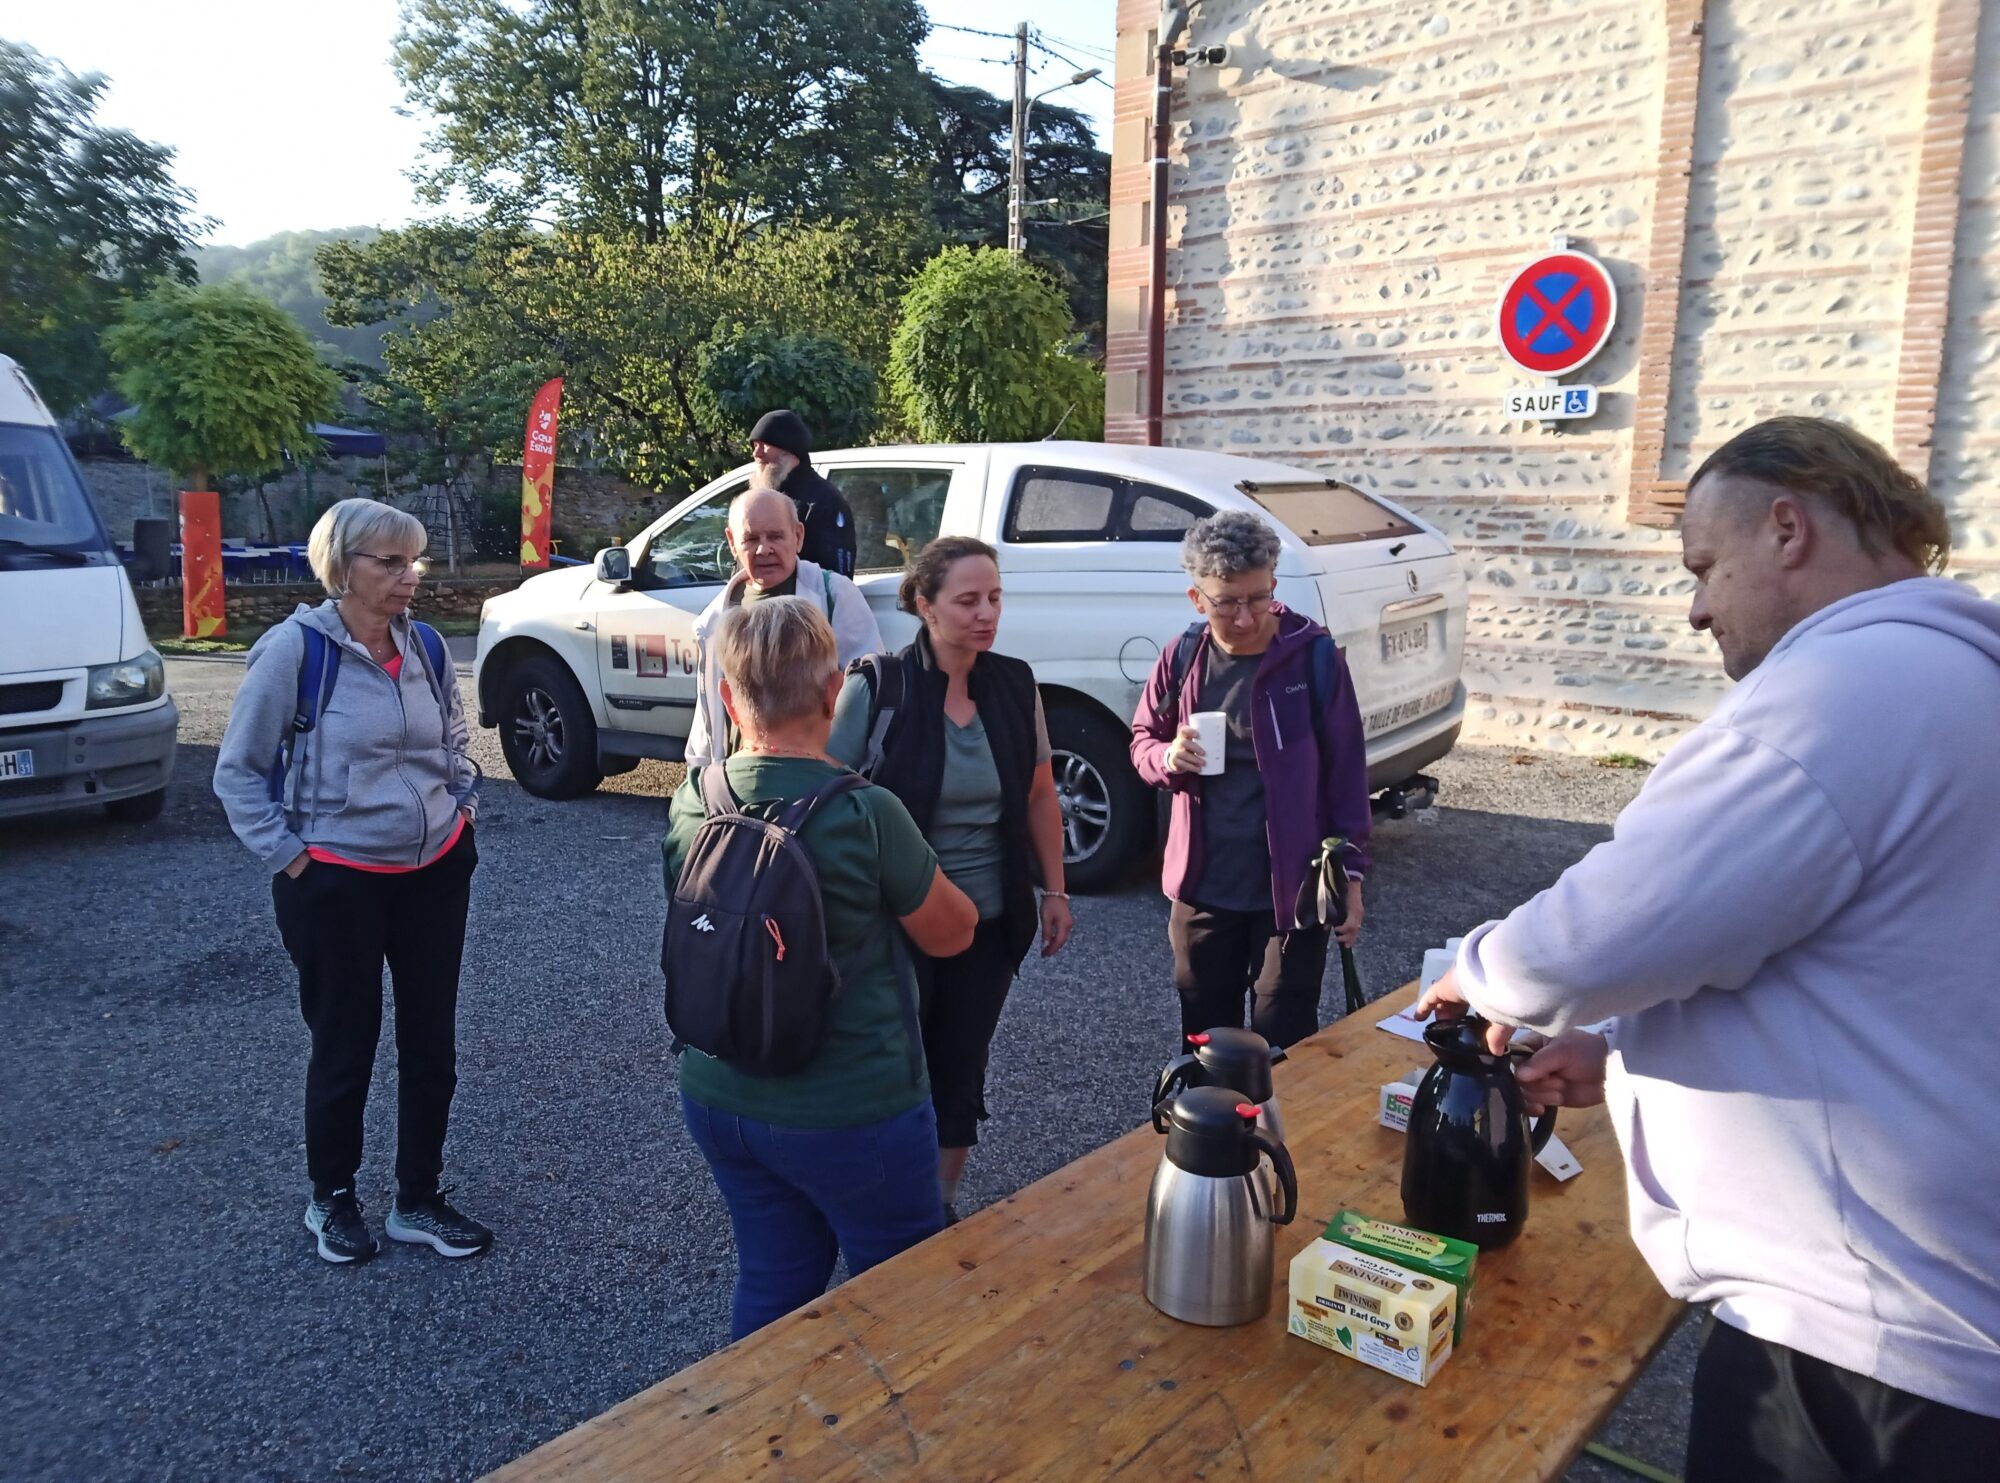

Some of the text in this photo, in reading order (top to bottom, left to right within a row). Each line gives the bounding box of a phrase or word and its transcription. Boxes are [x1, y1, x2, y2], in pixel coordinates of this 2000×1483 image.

[1512, 395, 1561, 412] SAUF
[1477, 1213, 1507, 1223] THERMOS
[1375, 1223, 1433, 1243] TWININGS
[1338, 1264, 1397, 1289] TWININGS
[1317, 1298, 1345, 1311] ORIGINAL
[1338, 1289, 1378, 1310] TWININGS
[1350, 1308, 1391, 1330] Earl Grey
